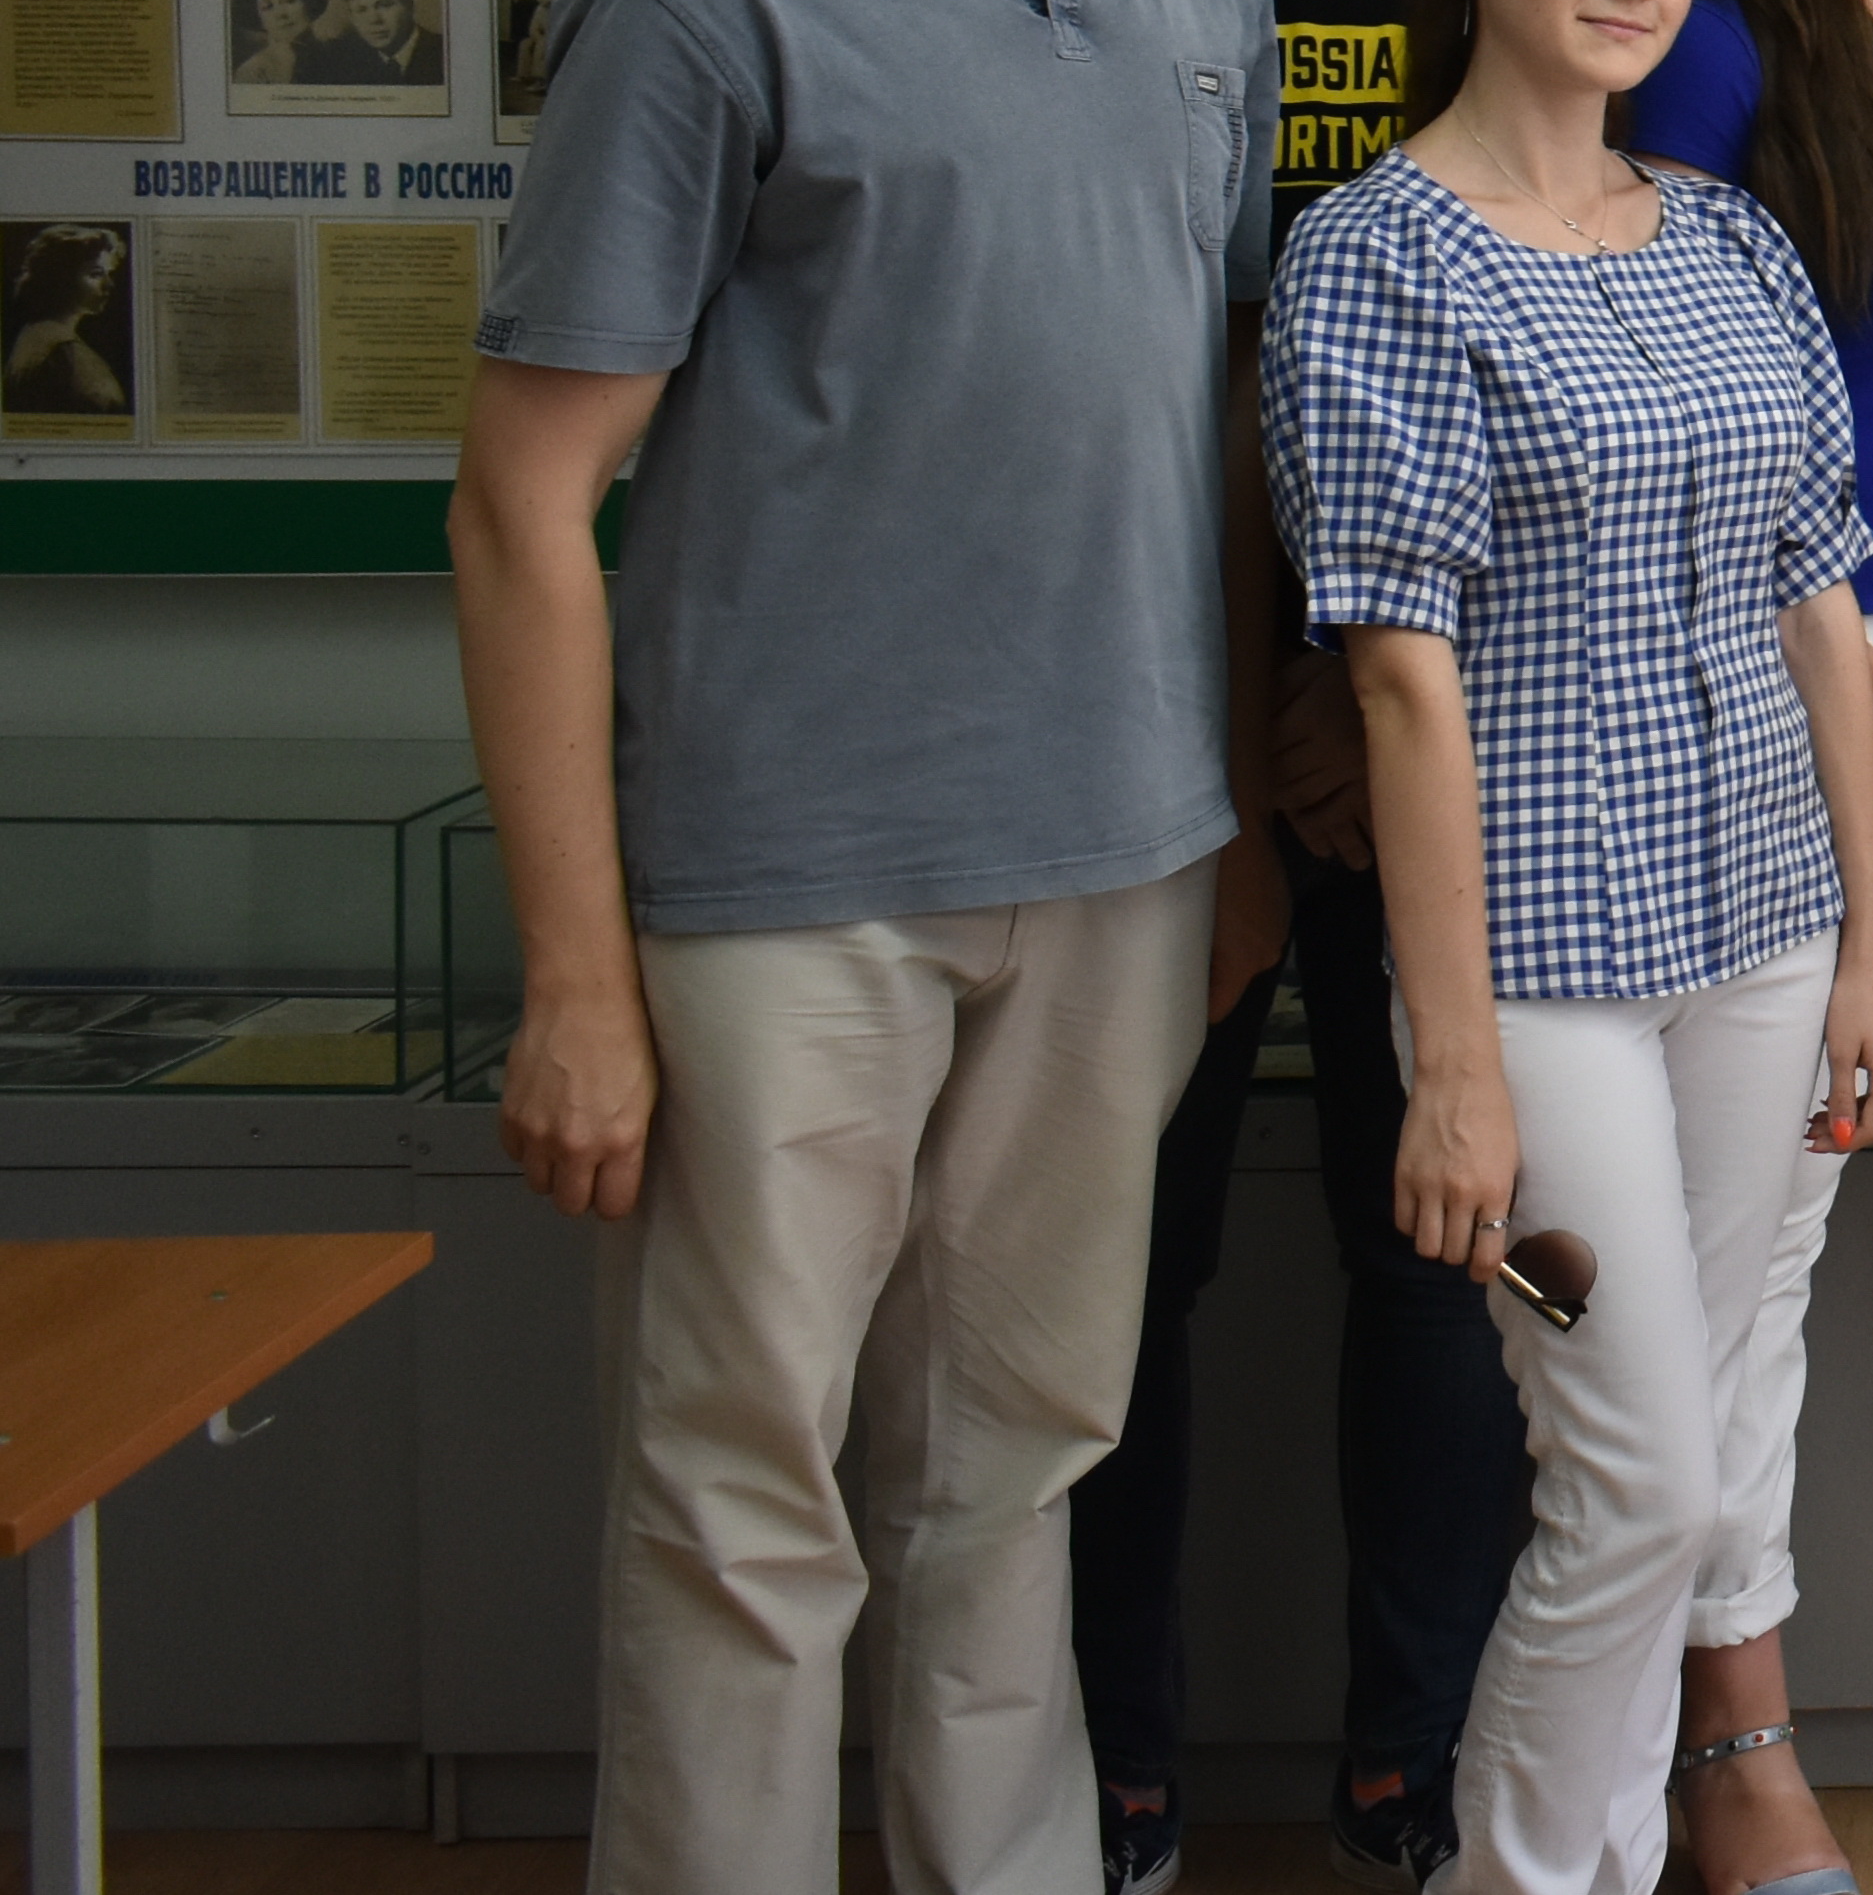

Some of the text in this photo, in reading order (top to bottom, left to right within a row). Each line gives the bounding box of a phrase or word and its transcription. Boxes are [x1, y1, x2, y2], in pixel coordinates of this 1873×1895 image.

[1279, 36, 1400, 91] SSIA
[1273, 114, 1406, 170] RTM
[134, 160, 513, 201] ВОЗВРАЩЕНИЕ В РОССИЮ
